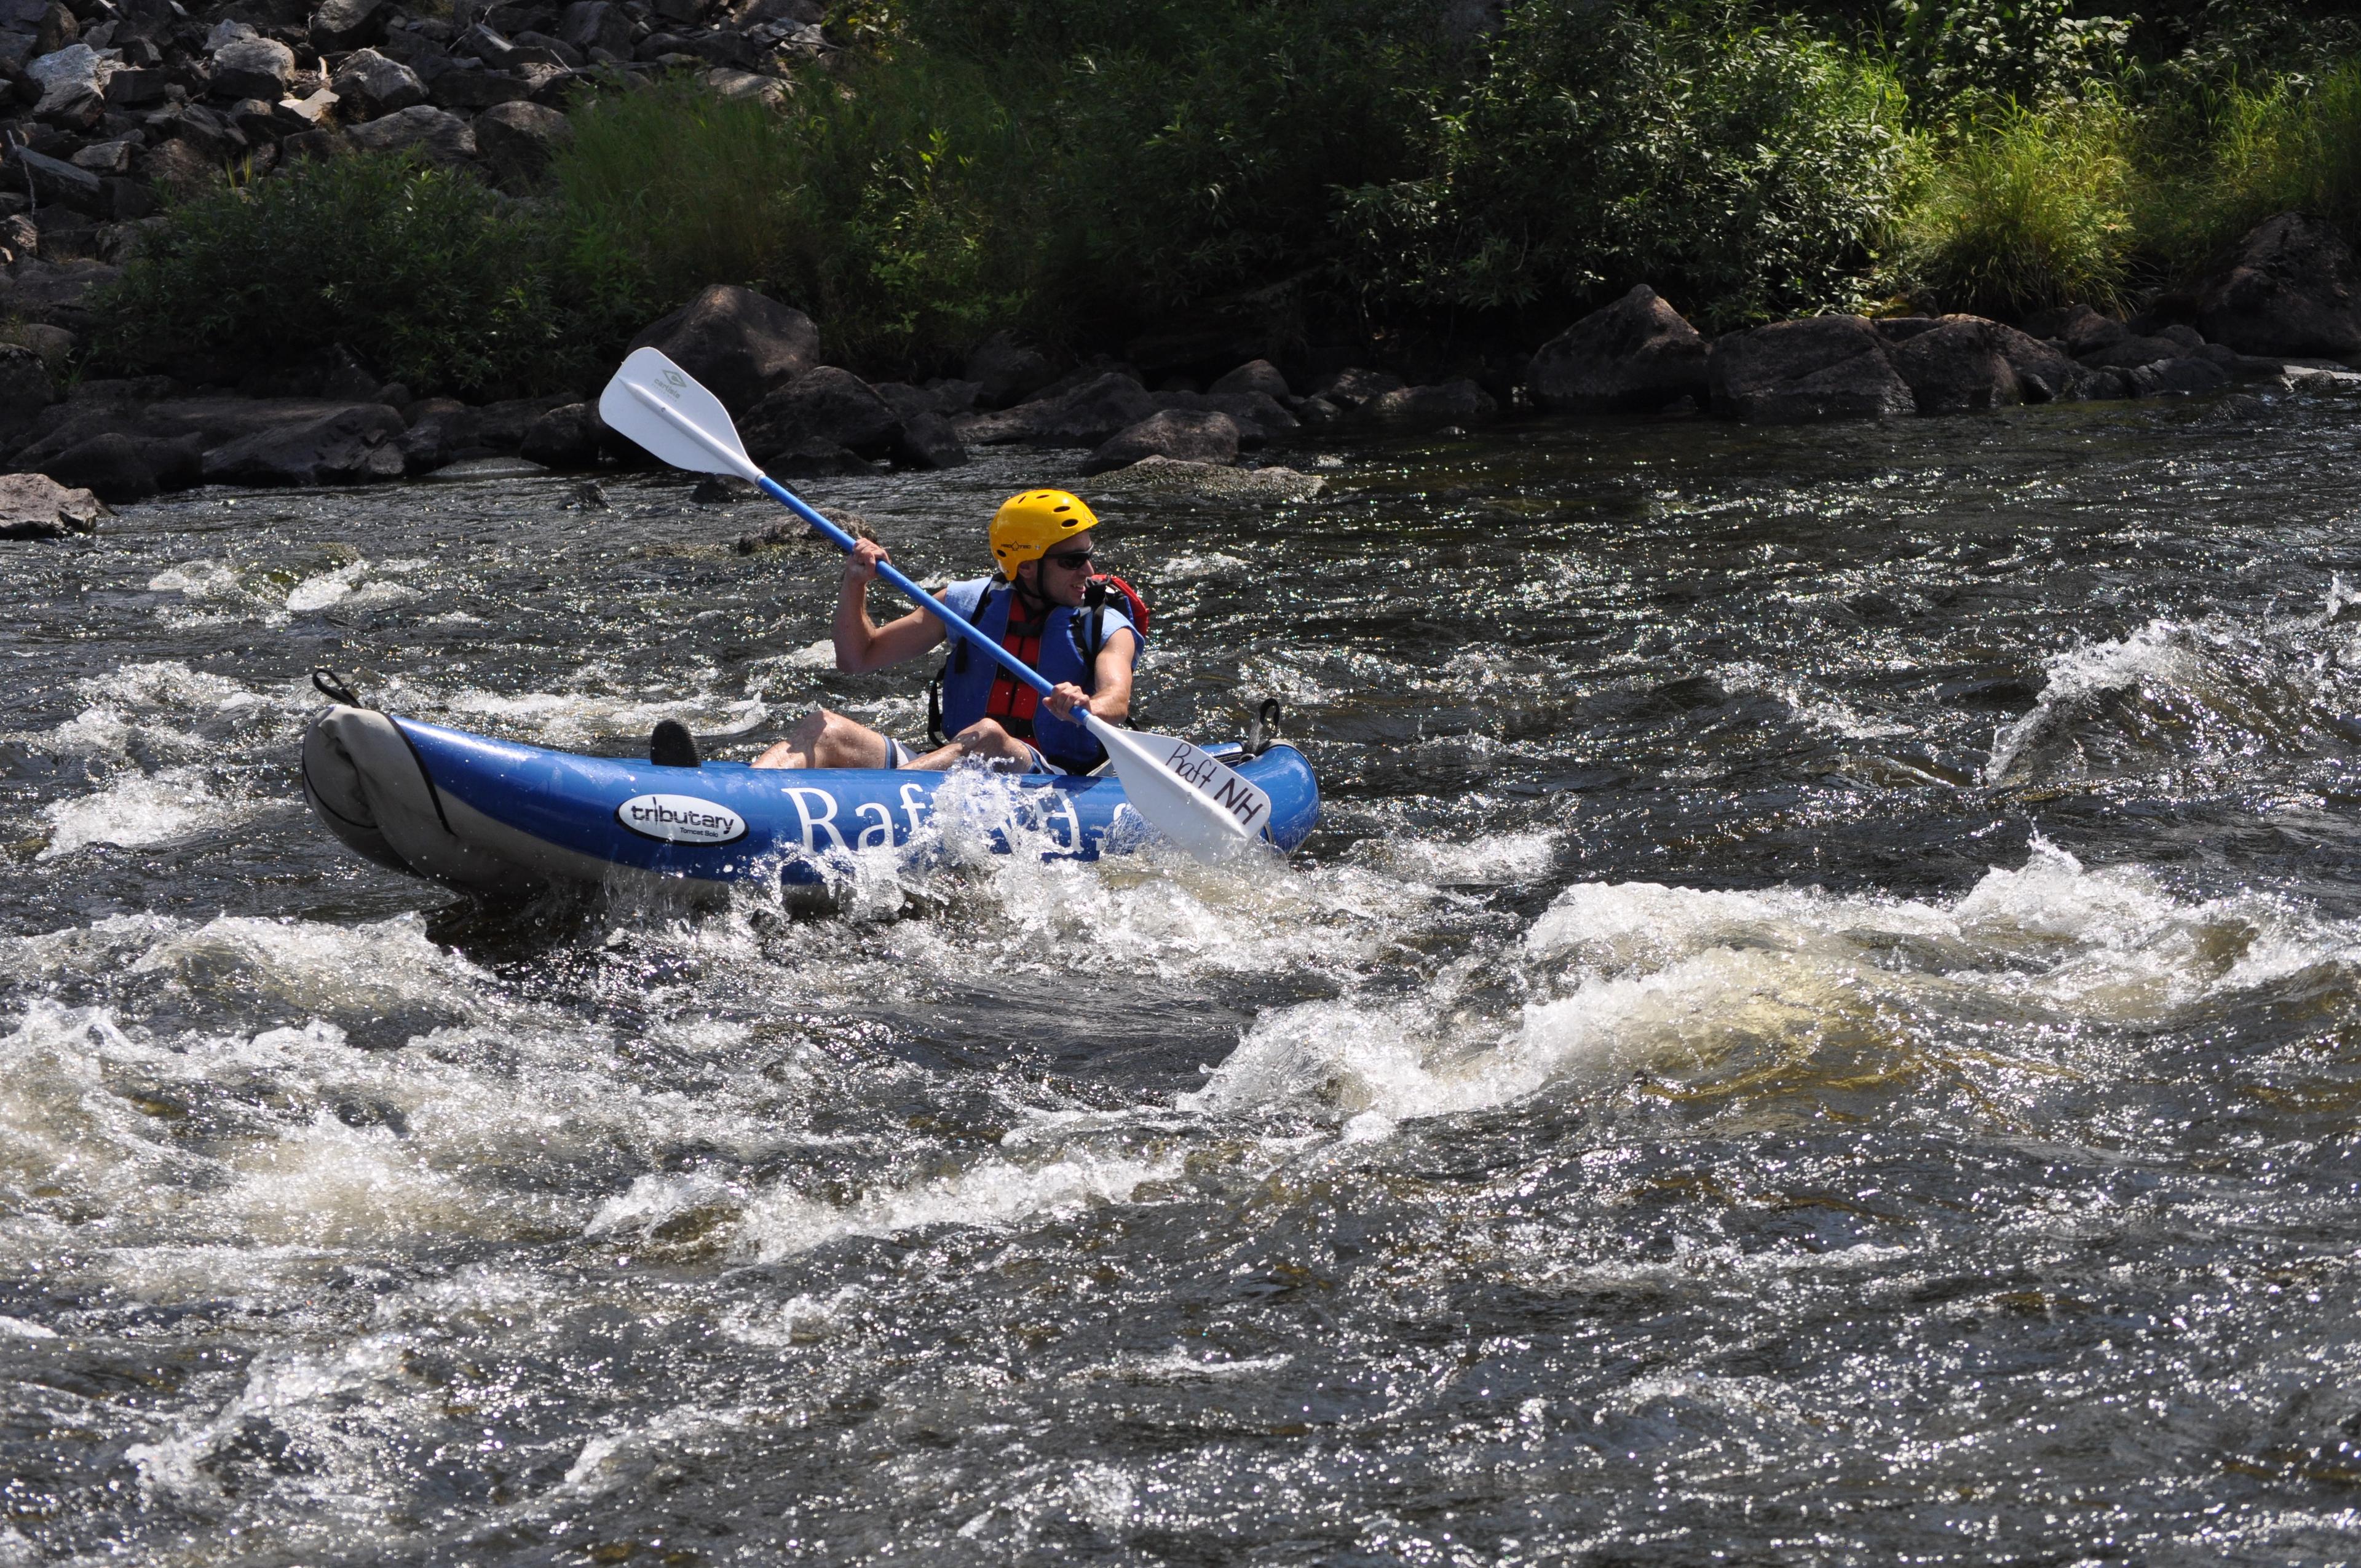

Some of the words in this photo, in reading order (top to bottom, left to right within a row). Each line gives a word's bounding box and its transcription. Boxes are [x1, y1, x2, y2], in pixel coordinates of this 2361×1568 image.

[1165, 742, 1217, 789] Raft
[1213, 777, 1264, 826] NH
[631, 796, 734, 835] tributary
[679, 827, 703, 836] Tomcat
[780, 783, 936, 856] Raf
